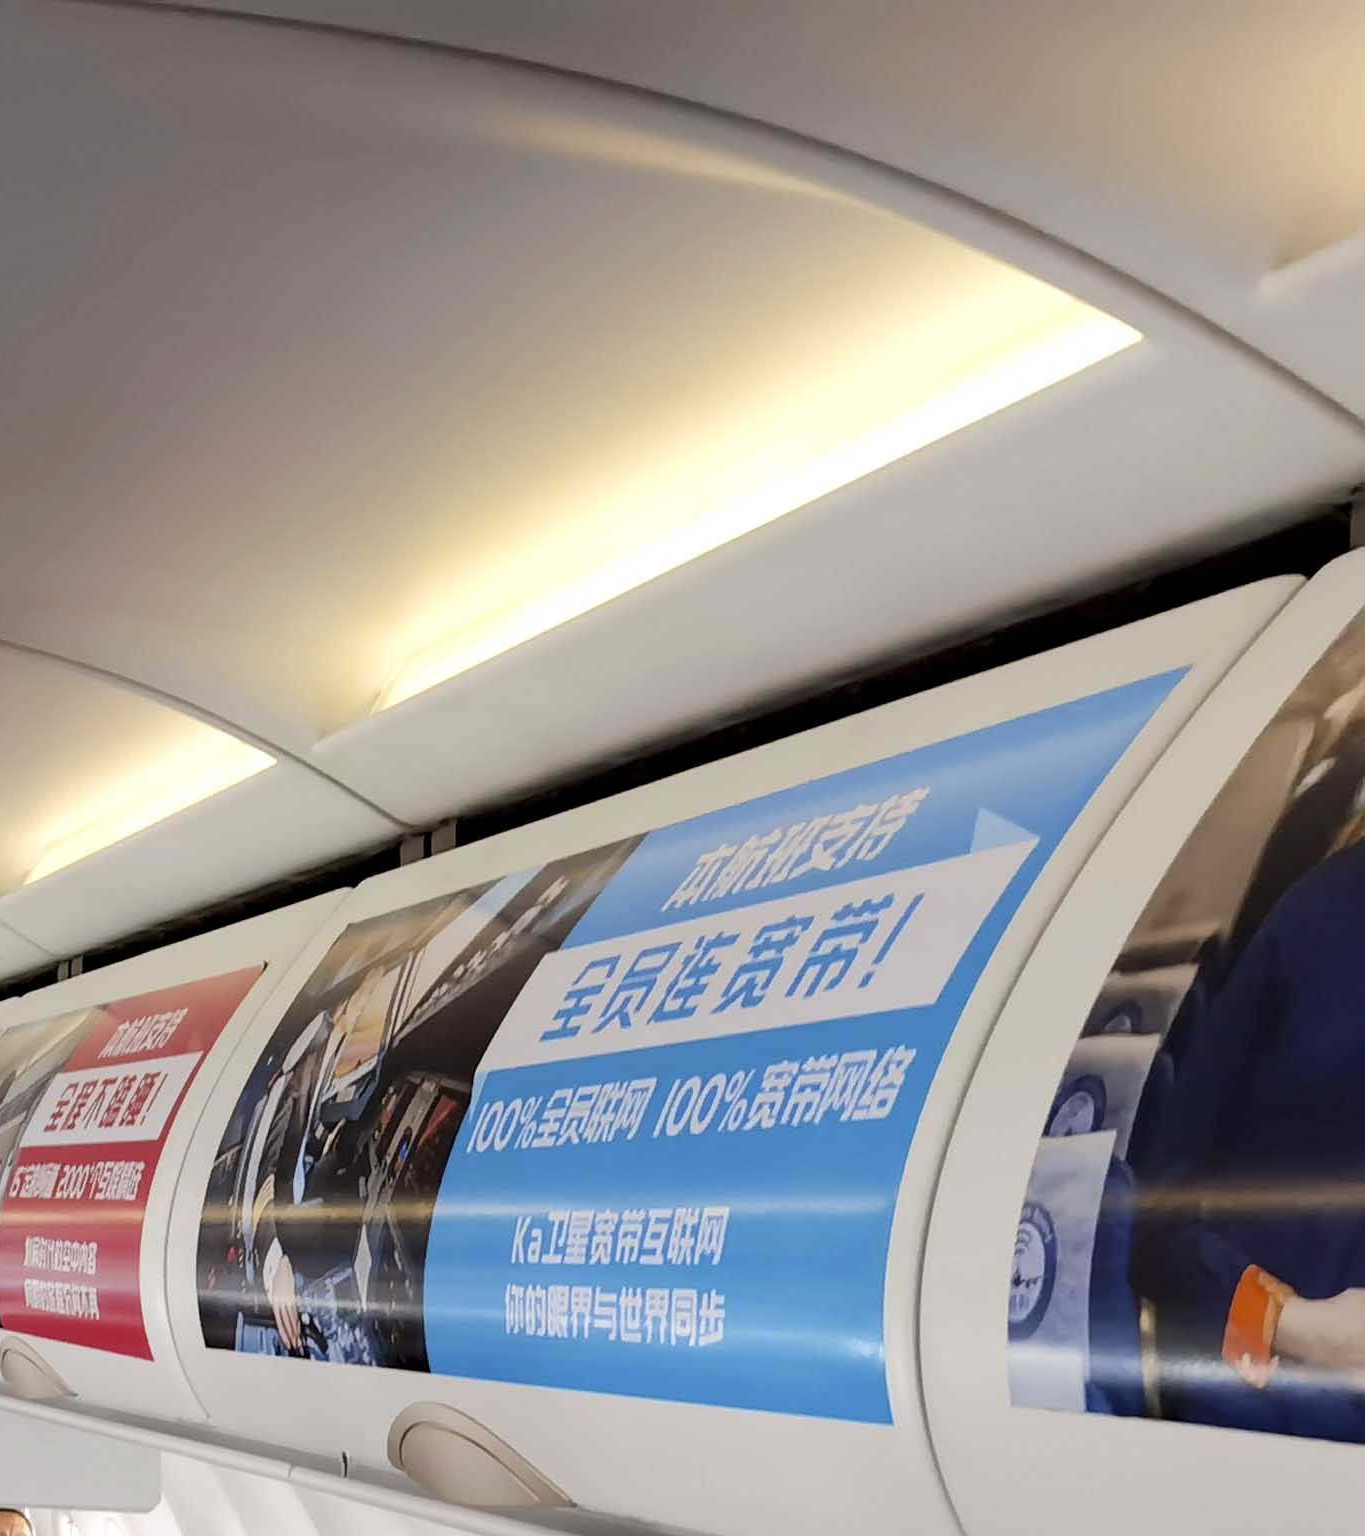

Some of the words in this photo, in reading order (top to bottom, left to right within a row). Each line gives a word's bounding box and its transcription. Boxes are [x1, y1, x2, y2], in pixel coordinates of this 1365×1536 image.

[467, 1075, 658, 1154] 100%全员联网
[652, 1044, 917, 1139] 100%宽带网络
[511, 1206, 730, 1265] Ka卫星宽带互联网
[504, 1283, 726, 1347] 你的眼界与世界同步
